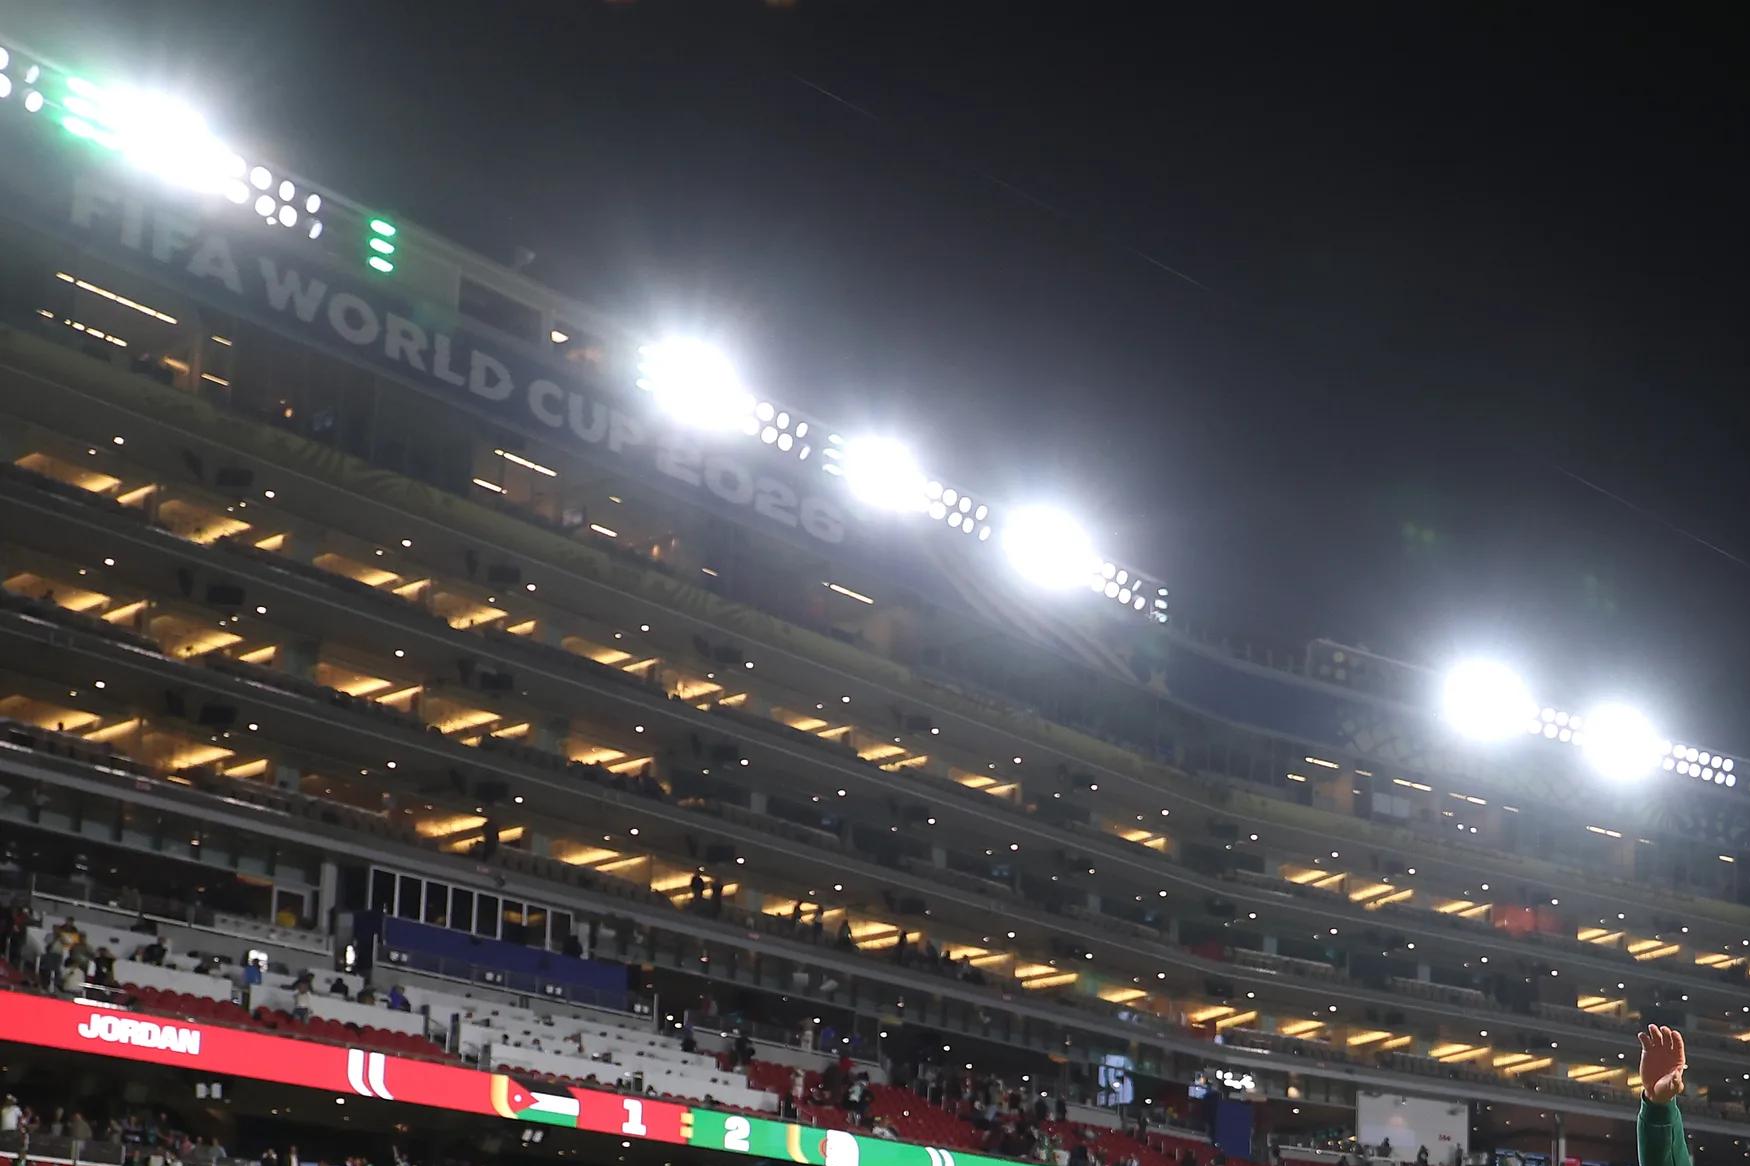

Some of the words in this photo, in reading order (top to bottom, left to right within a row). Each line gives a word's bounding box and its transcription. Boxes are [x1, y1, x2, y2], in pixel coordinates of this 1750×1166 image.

[70, 172, 244, 294] FIFA
[259, 256, 514, 401] WORLD
[527, 379, 647, 450] CUP
[655, 444, 846, 543] 2026
[78, 1013, 200, 1055] JORDAN
[622, 1099, 646, 1136] 1
[724, 1115, 750, 1152] 2
